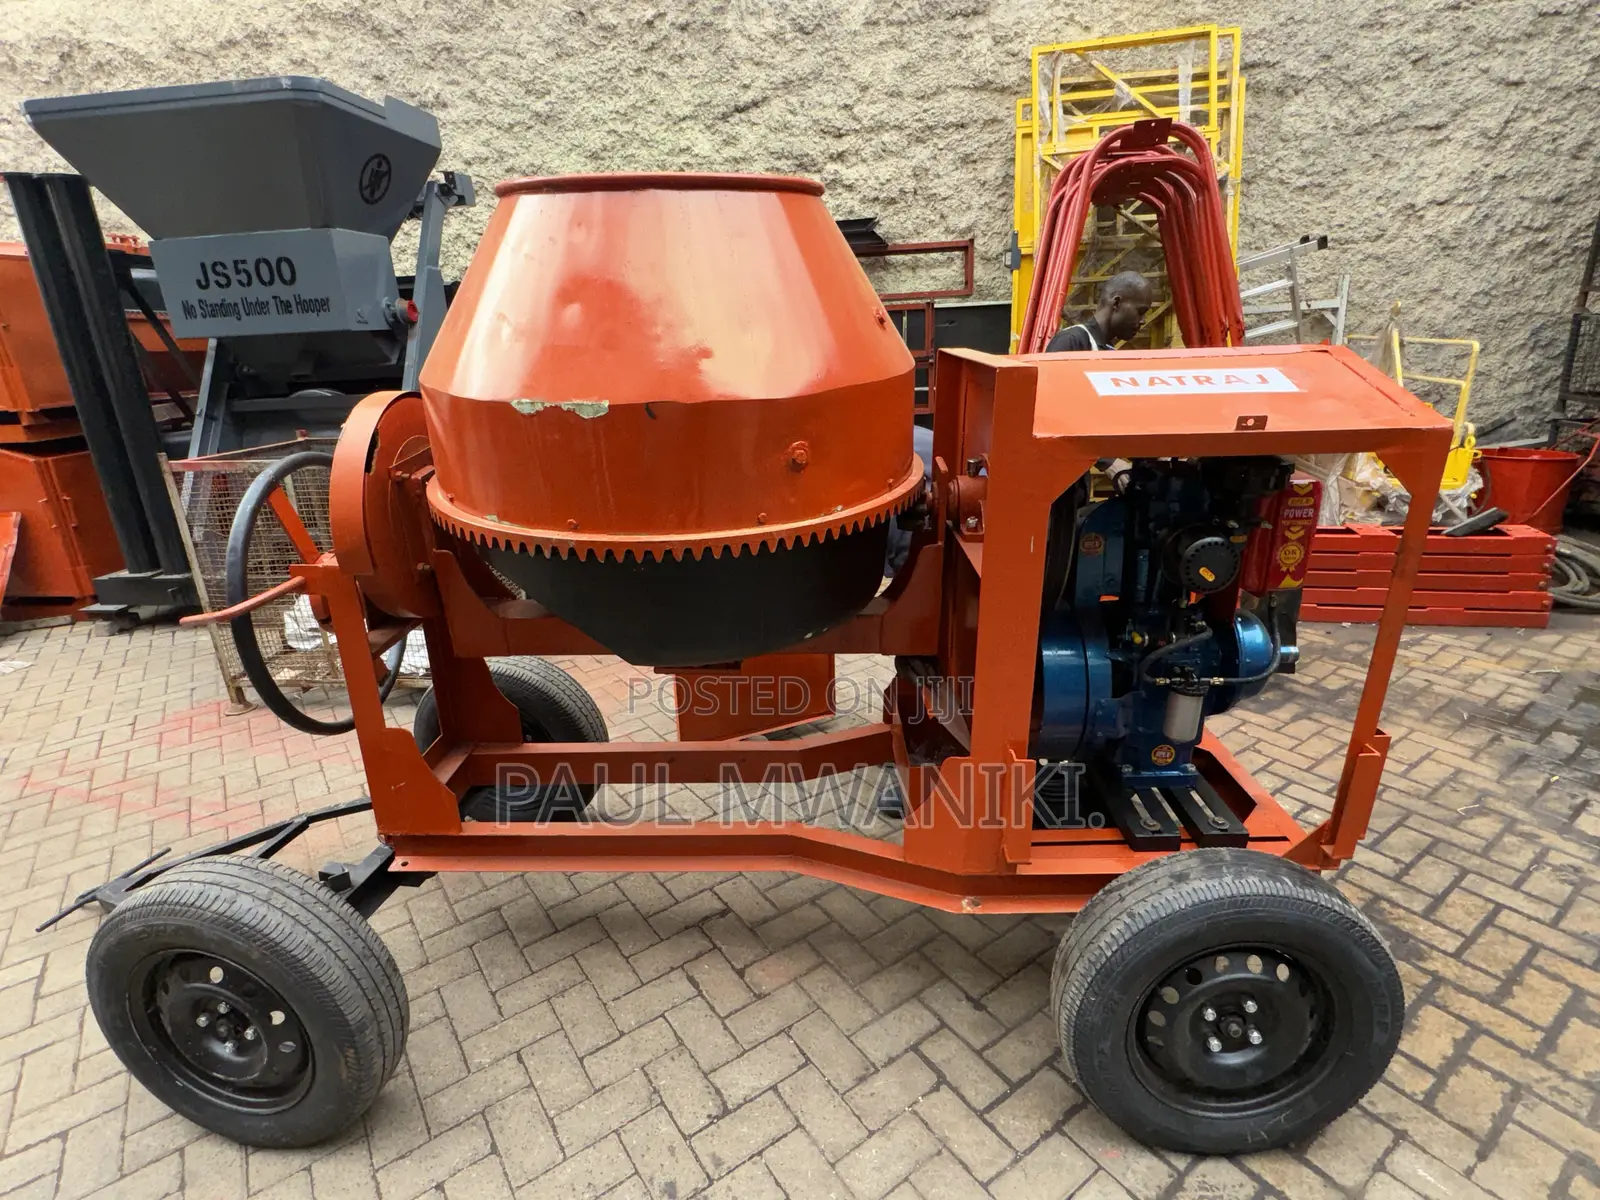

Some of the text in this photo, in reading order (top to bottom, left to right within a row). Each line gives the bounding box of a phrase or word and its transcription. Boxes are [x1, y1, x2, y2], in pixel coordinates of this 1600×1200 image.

[196, 256, 296, 290] JS500
[181, 294, 331, 321] No Standing Under The Hooper
[1110, 373, 1270, 388] NATRAJ
[1284, 508, 1314, 518] POWER
